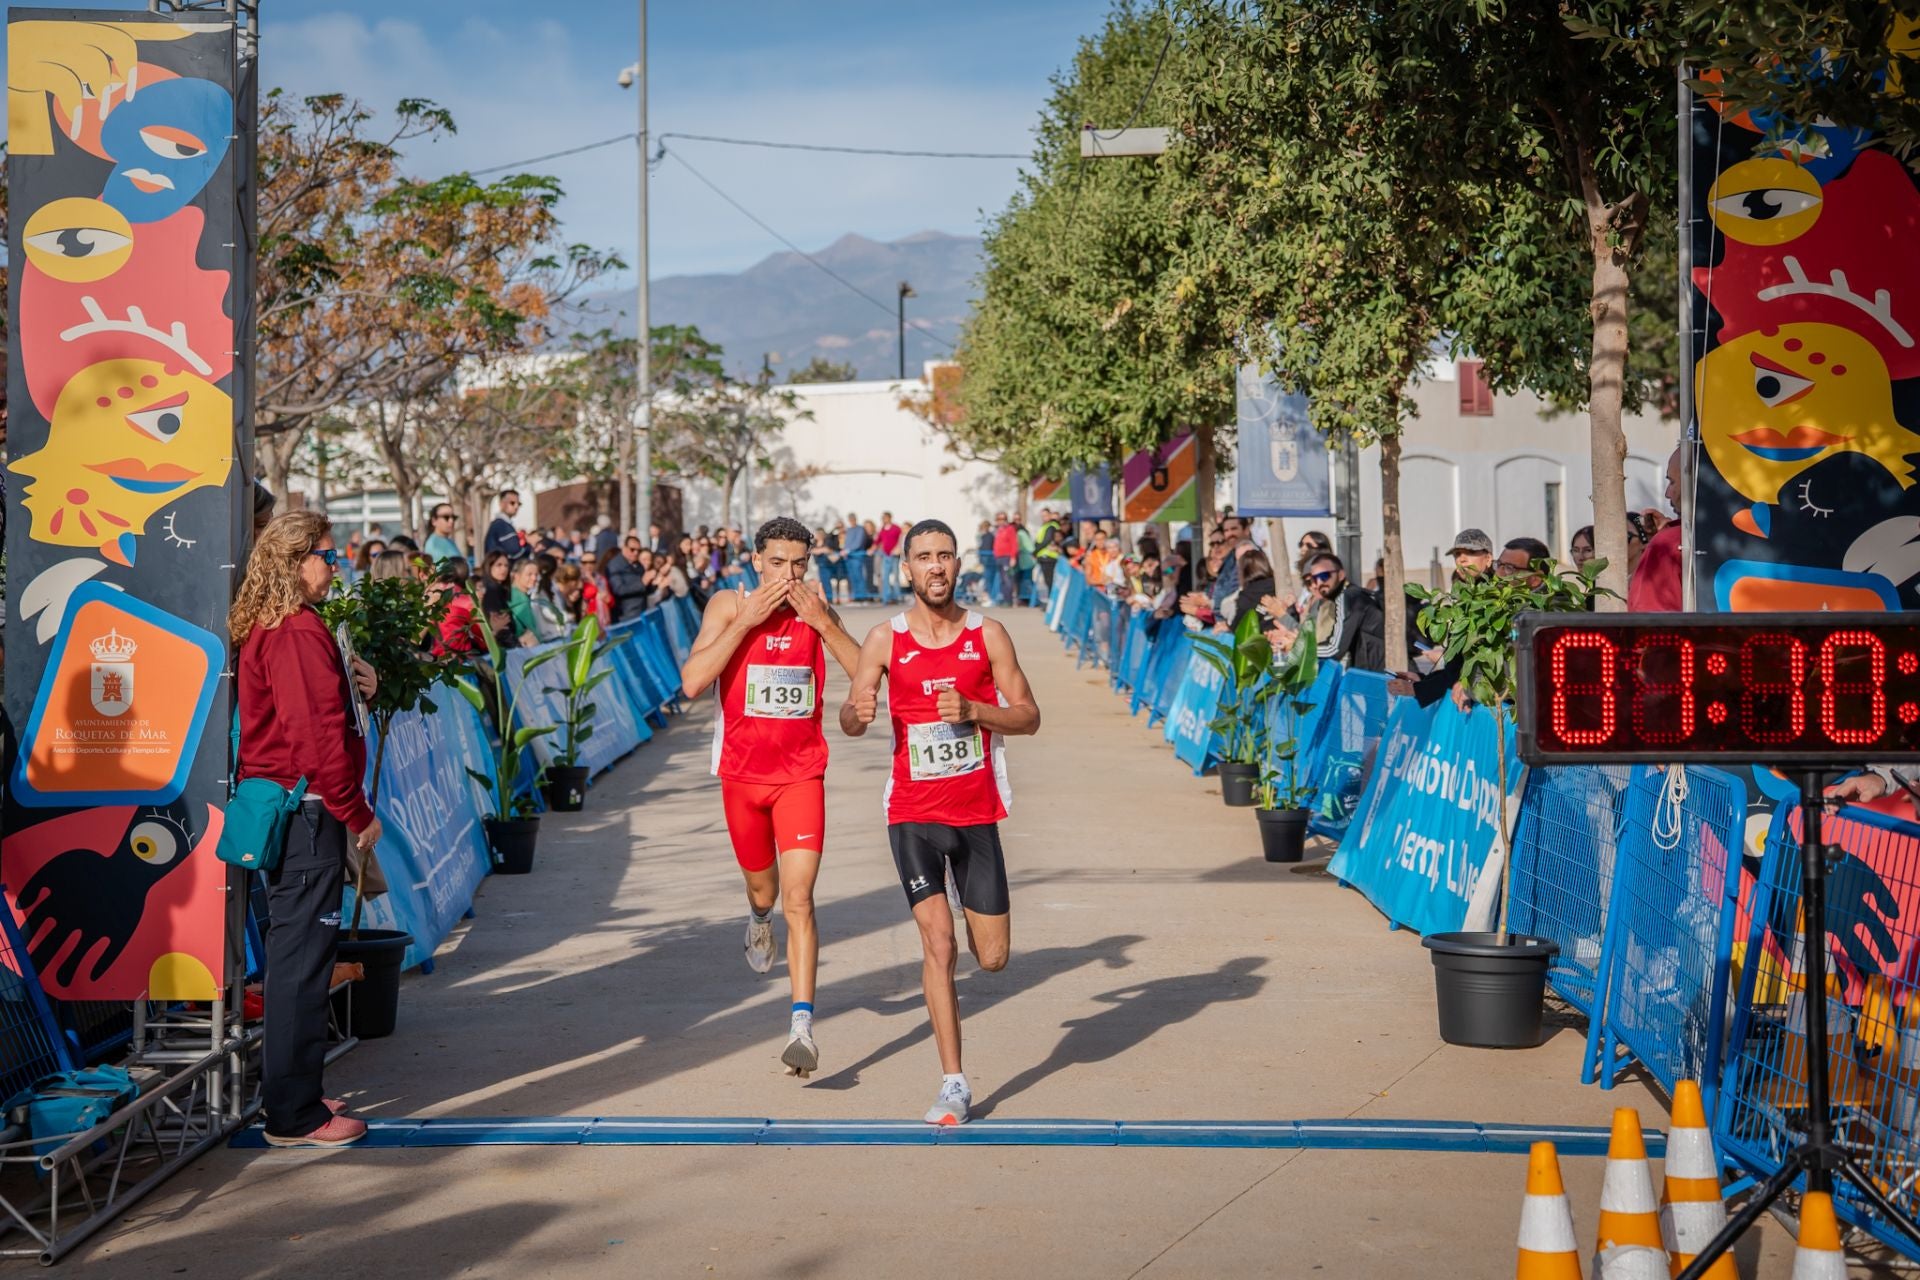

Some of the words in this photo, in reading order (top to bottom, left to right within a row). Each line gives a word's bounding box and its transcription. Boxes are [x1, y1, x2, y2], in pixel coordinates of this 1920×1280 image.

[760, 686, 803, 704] 139
[75, 719, 137, 727] AYUNTAMIENTO
[140, 719, 150, 727] DE
[55, 728, 116, 741] ROQUETAS
[120, 730, 135, 740] DE
[139, 728, 167, 740] MAR
[923, 740, 969, 764] 138
